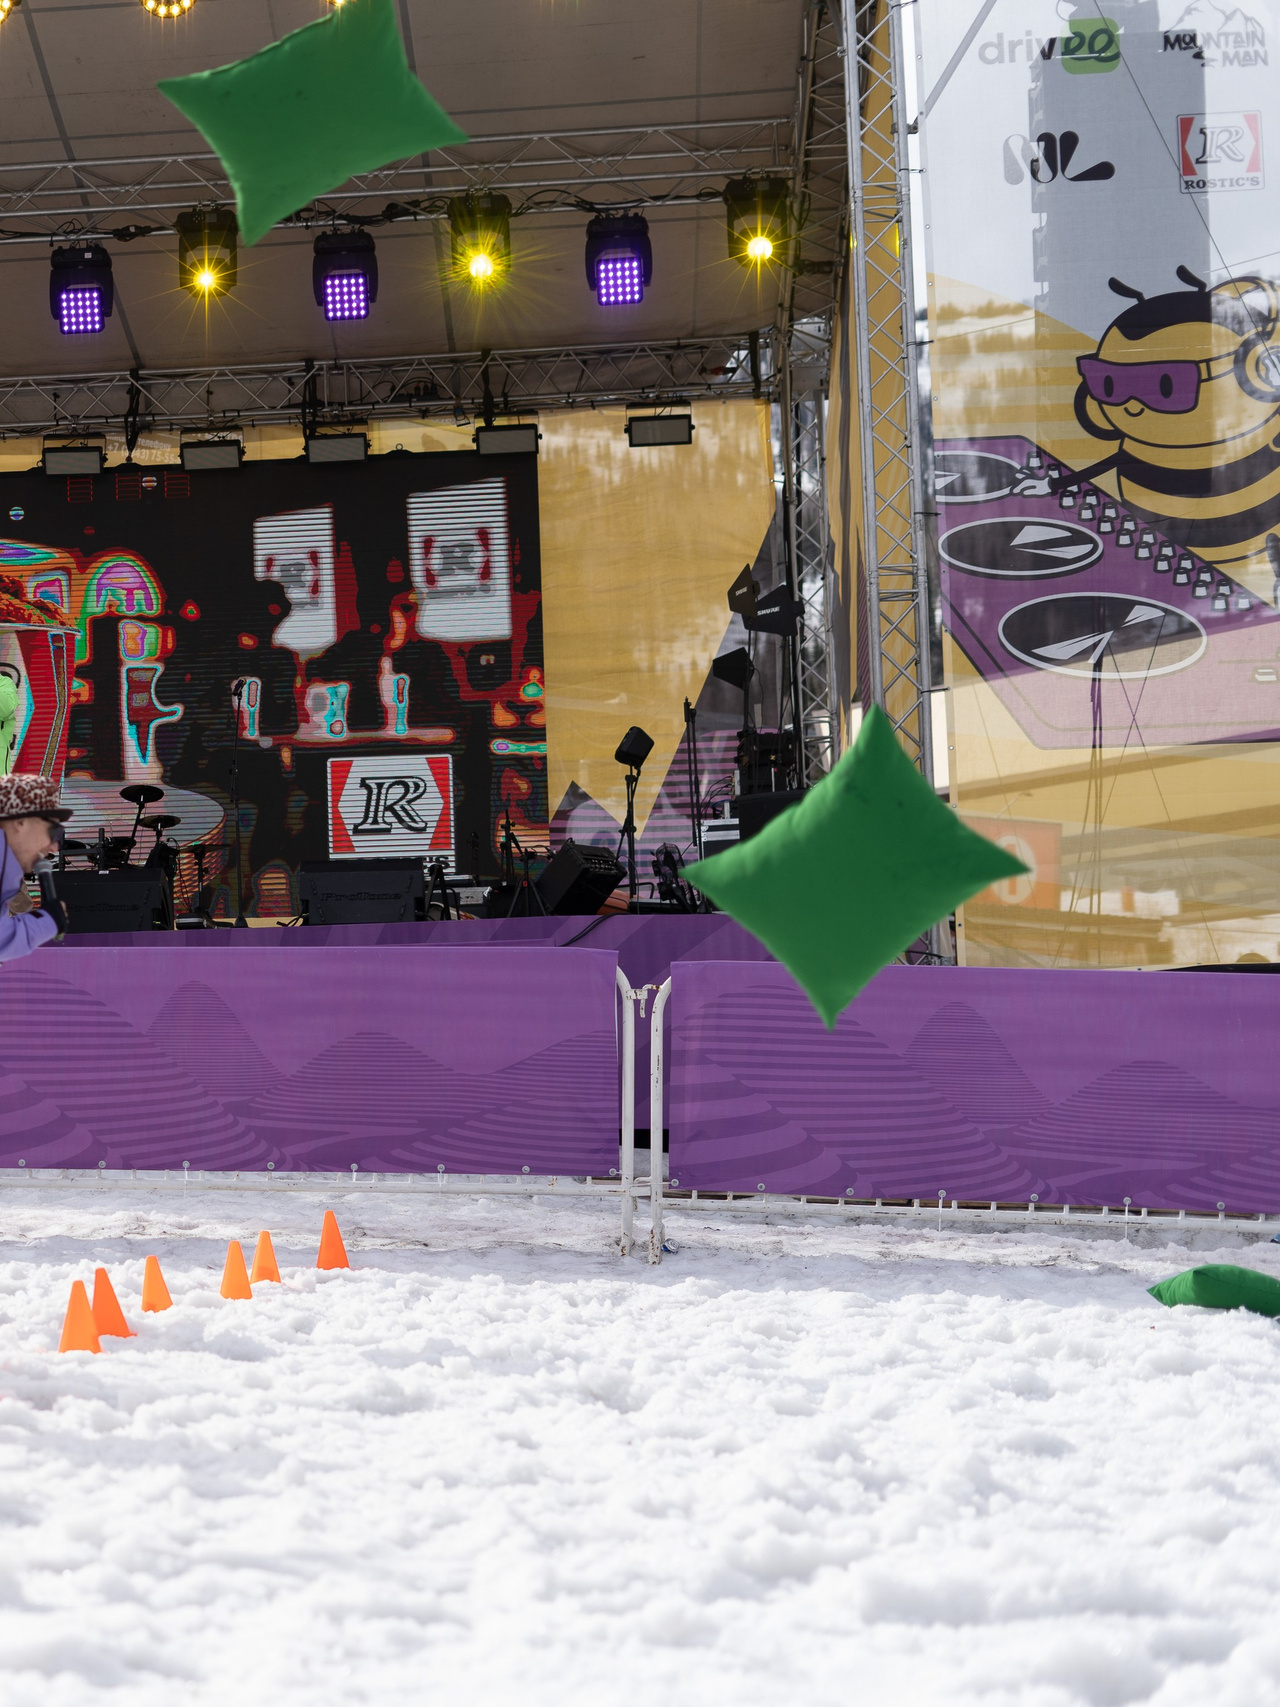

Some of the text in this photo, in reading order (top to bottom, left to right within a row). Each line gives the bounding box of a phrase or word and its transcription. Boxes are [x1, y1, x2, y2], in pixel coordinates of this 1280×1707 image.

[1222, 49, 1269, 67] MAN
[1184, 176, 1260, 190] ROSTIC'S
[757, 606, 781, 616] SHURE
